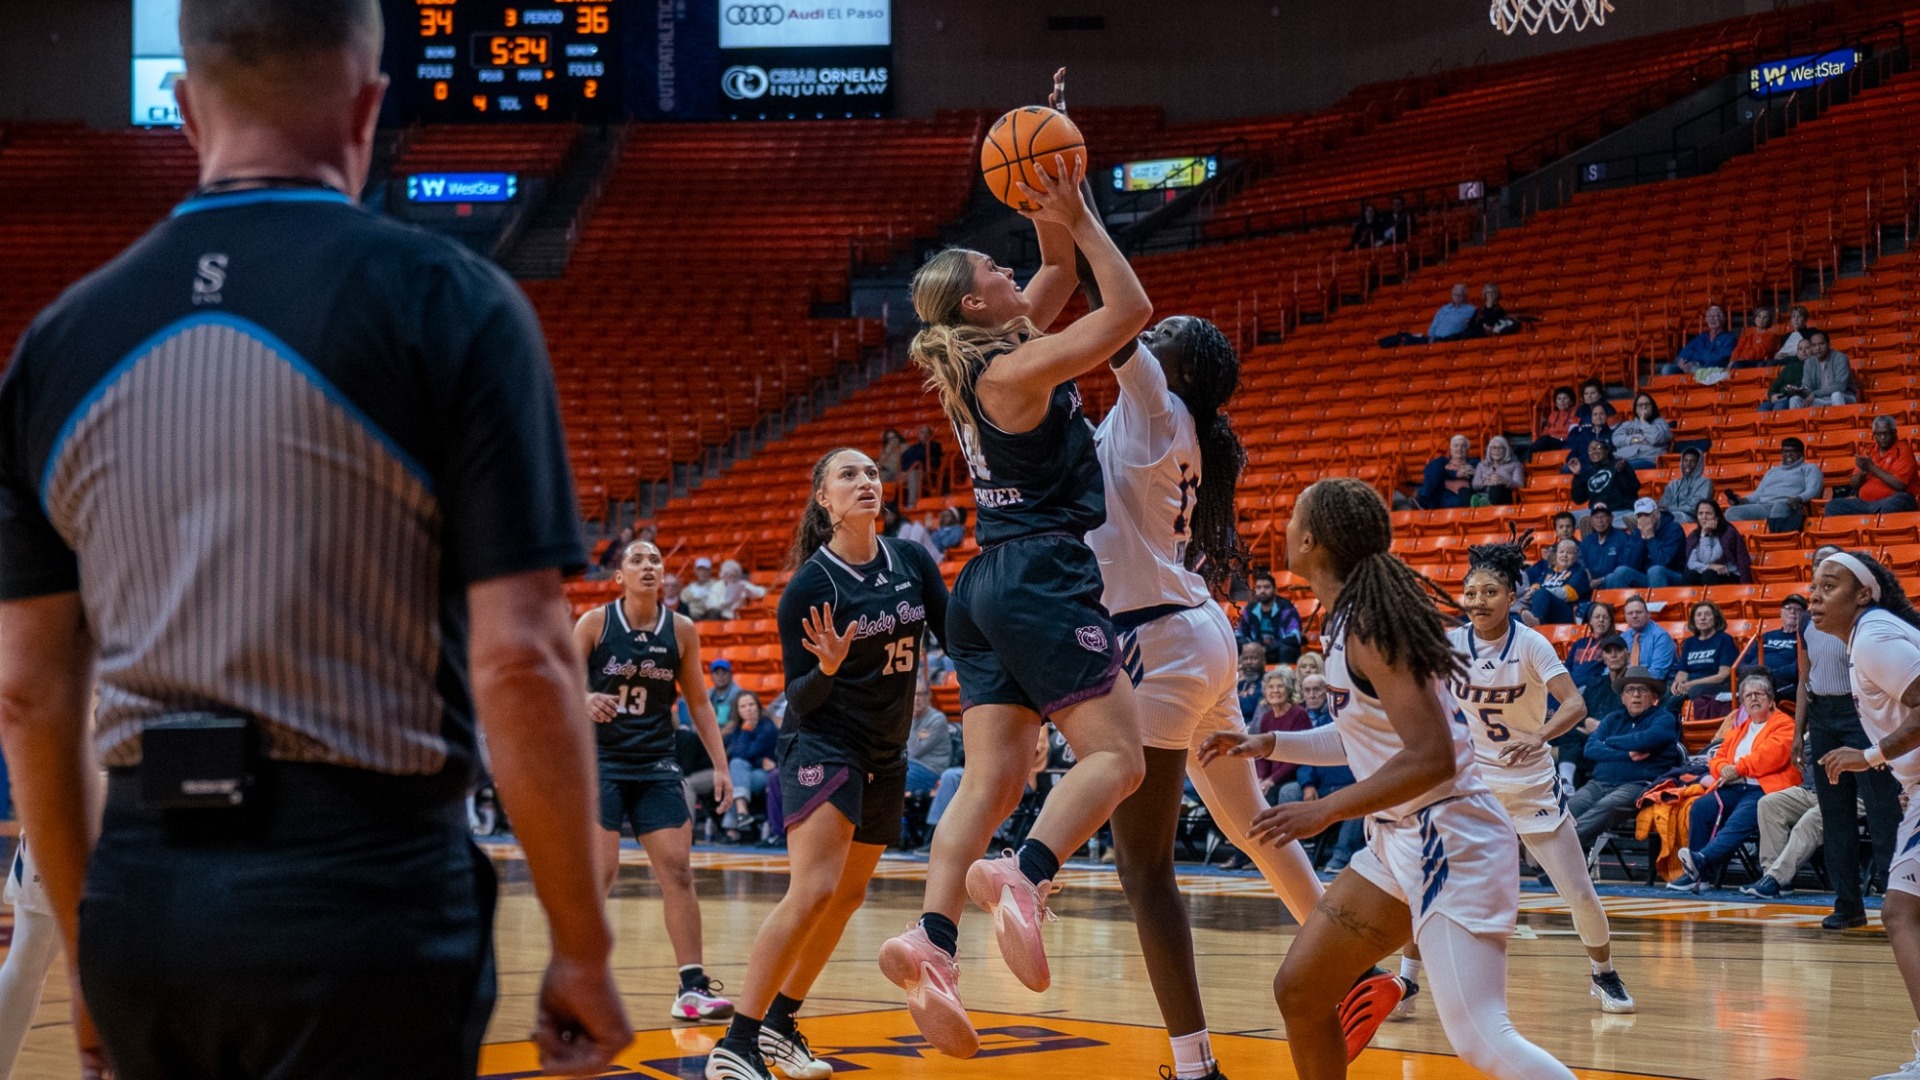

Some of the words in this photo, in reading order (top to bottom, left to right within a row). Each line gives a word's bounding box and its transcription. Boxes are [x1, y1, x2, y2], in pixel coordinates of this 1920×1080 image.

[420, 8, 453, 36] 34
[504, 8, 517, 27] 3
[523, 10, 564, 24] PERIOD
[577, 6, 609, 34] 36
[787, 9, 825, 20] Audi
[827, 9, 841, 19] El
[846, 9, 884, 19] Paso
[490, 37, 547, 64] 5:24
[417, 64, 454, 79] FOULS
[568, 62, 604, 77] FOULS
[769, 68, 817, 84] CESAR
[819, 67, 888, 83] ORNELAS
[434, 82, 448, 100] 0
[584, 80, 598, 98] 2
[770, 84, 839, 97] INJURY
[844, 83, 888, 95] LAW
[472, 95, 488, 112] 4
[498, 96, 522, 111] TOL
[535, 94, 549, 111] 4
[1589, 165, 1598, 181] S
[448, 181, 499, 195] WestStar
[852, 614, 896, 640] Lady
[882, 637, 914, 676] 15
[1687, 650, 1716, 661] UTEP
[603, 656, 637, 679] Lady
[639, 660, 674, 681] Bears
[616, 685, 647, 715] 13
[1455, 682, 1527, 704] UTEP
[1478, 708, 1510, 742] 5
